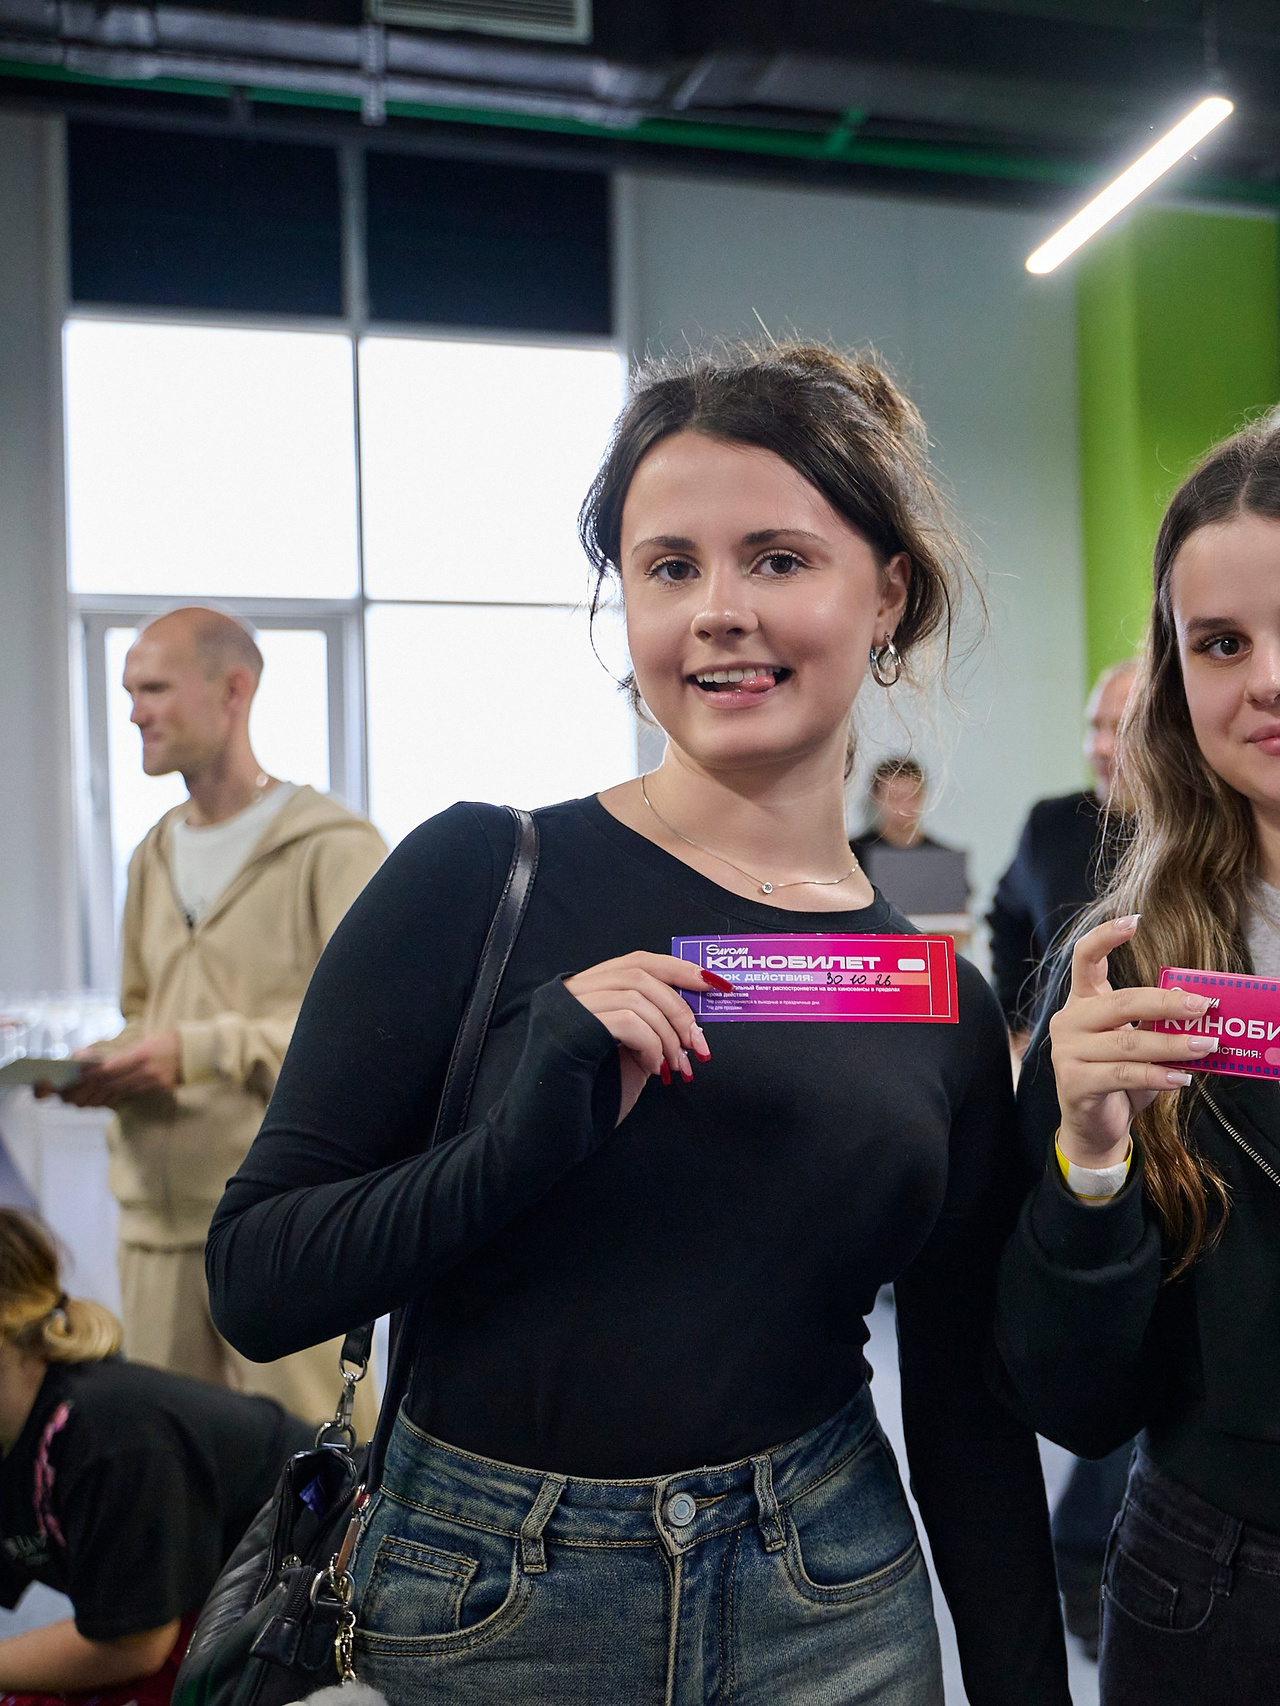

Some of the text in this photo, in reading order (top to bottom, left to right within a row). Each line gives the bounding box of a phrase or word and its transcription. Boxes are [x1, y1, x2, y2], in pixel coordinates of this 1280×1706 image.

[706, 955, 881, 970] КИНОБИЛЕТ
[744, 972, 814, 983] ДЕЙСТВИЯ:
[1218, 1046, 1262, 1059] СТВИЯ:
